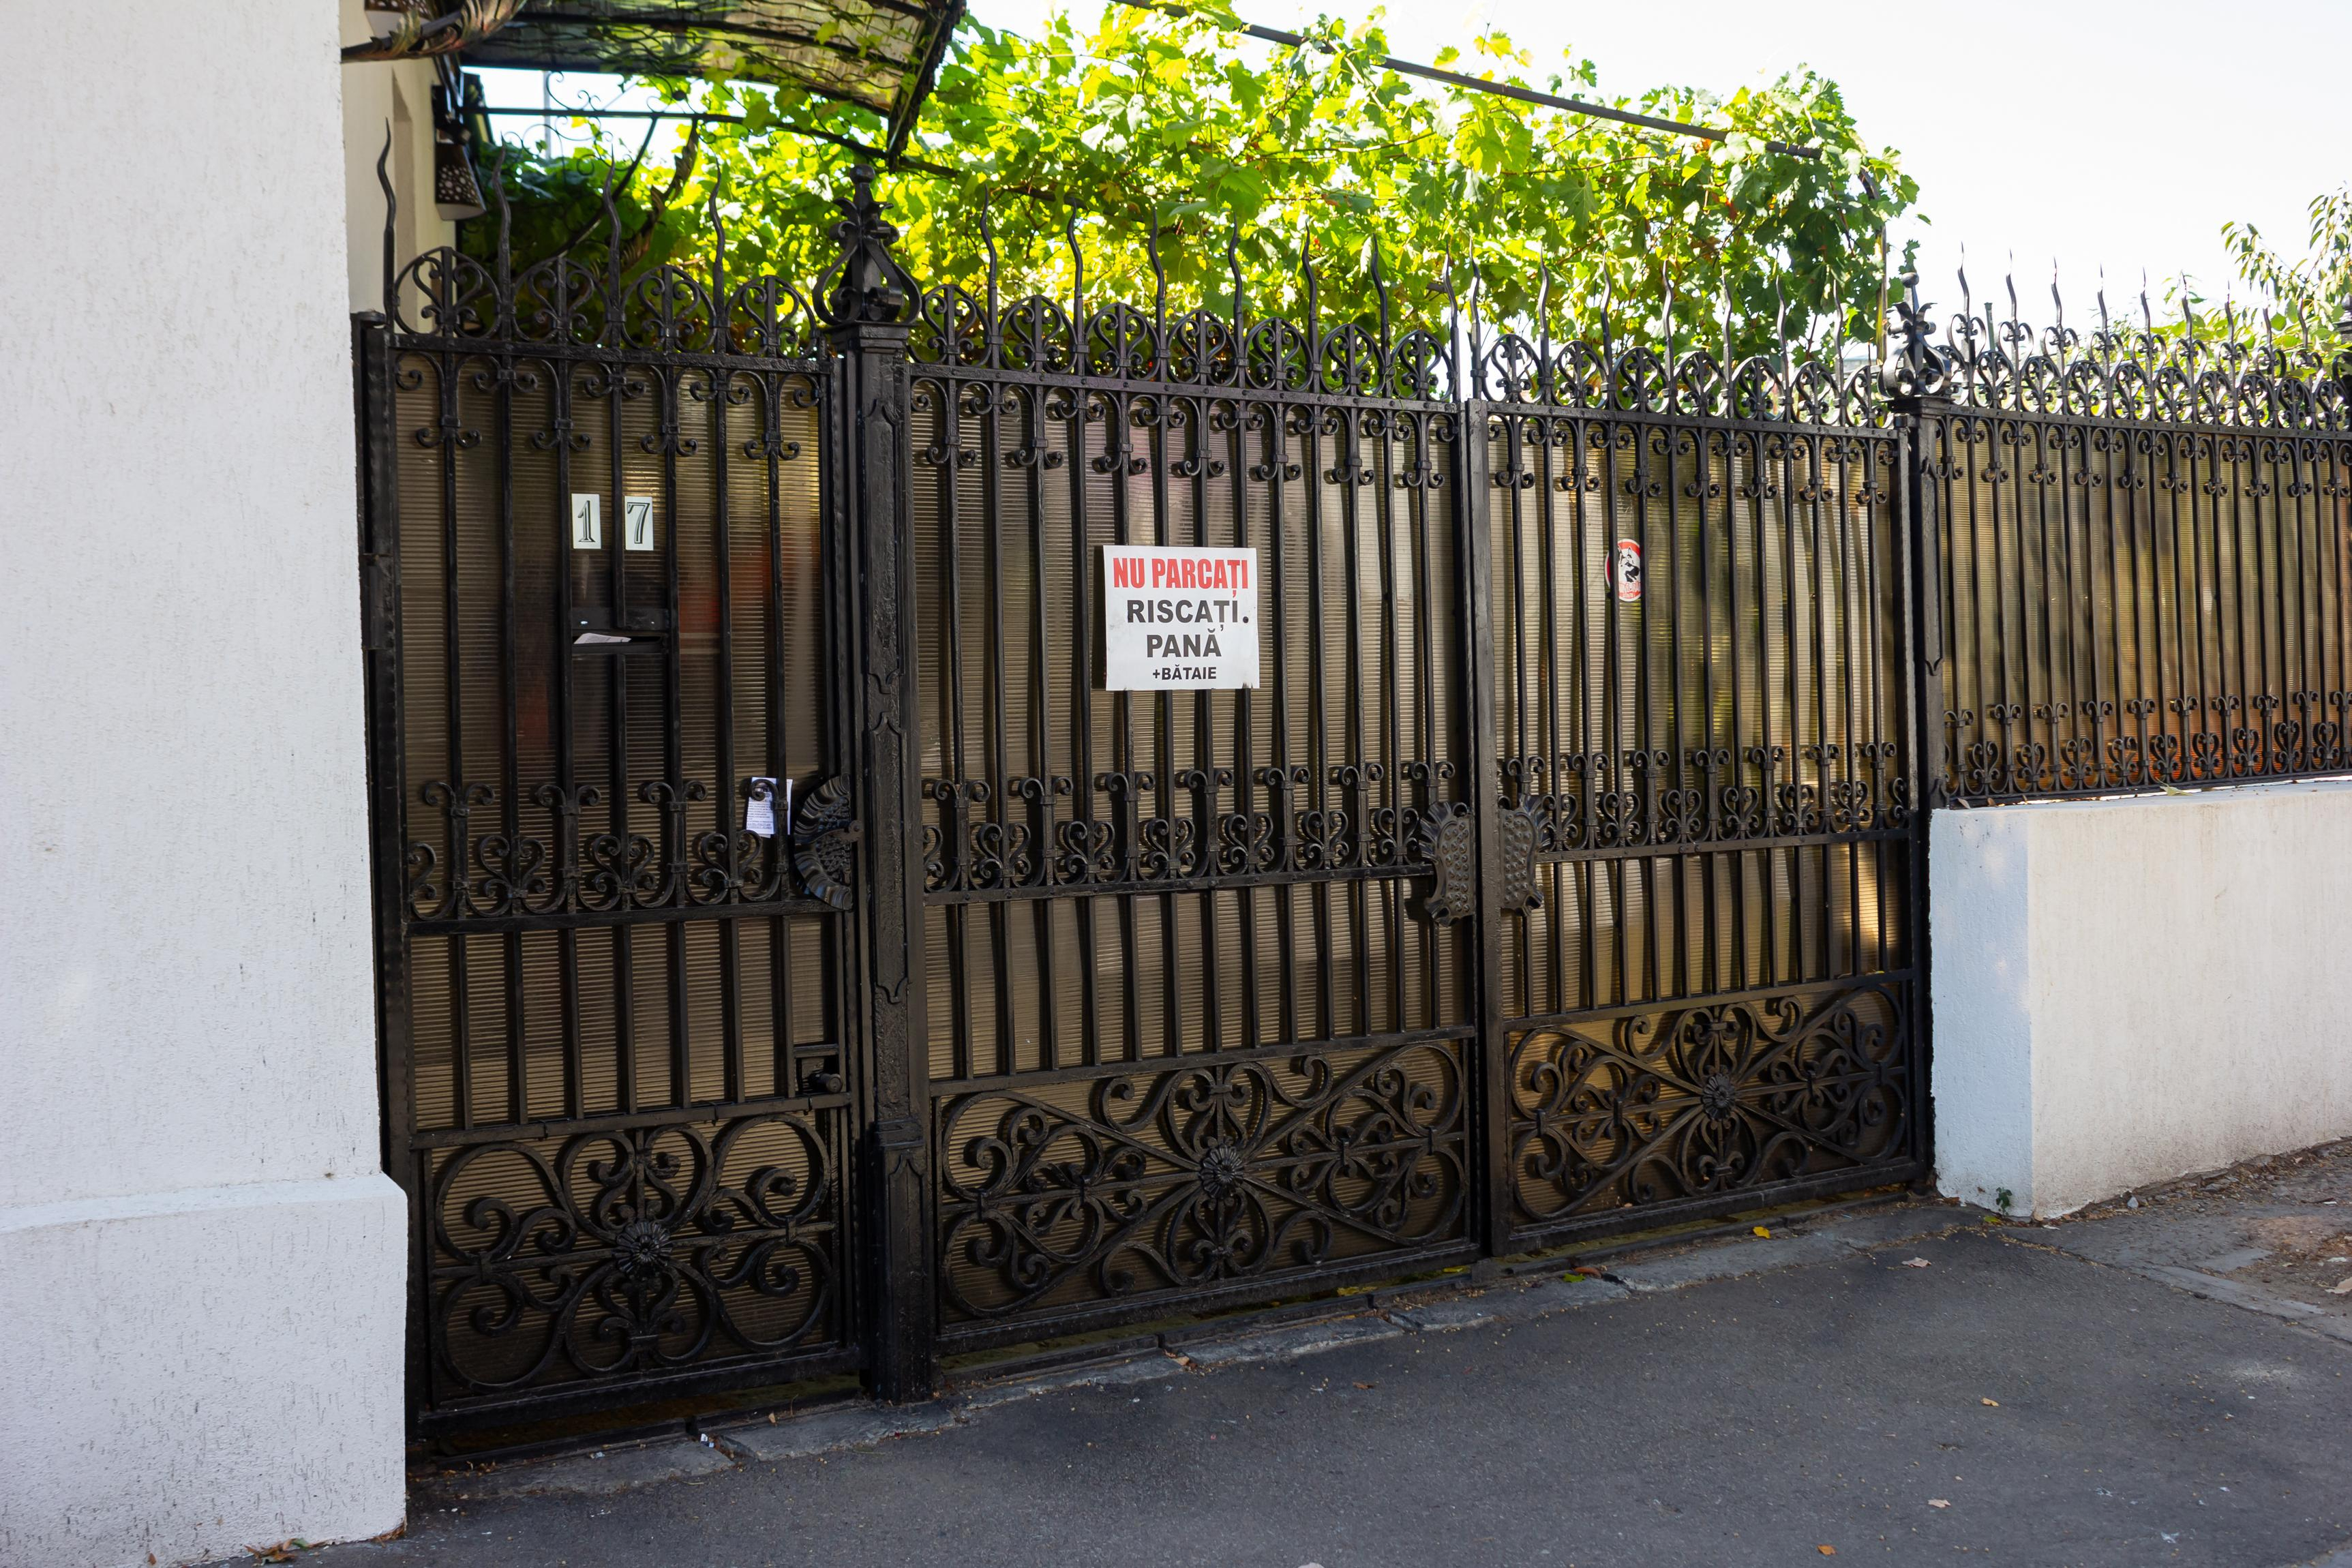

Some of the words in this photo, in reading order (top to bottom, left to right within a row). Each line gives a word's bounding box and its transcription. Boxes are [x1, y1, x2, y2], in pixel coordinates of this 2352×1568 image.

[1113, 558, 1145, 588] NU
[1151, 558, 1248, 597] PARCAȚI
[1147, 628, 1222, 657] PANĂ
[1152, 663, 1217, 680] +BĂTAIE
